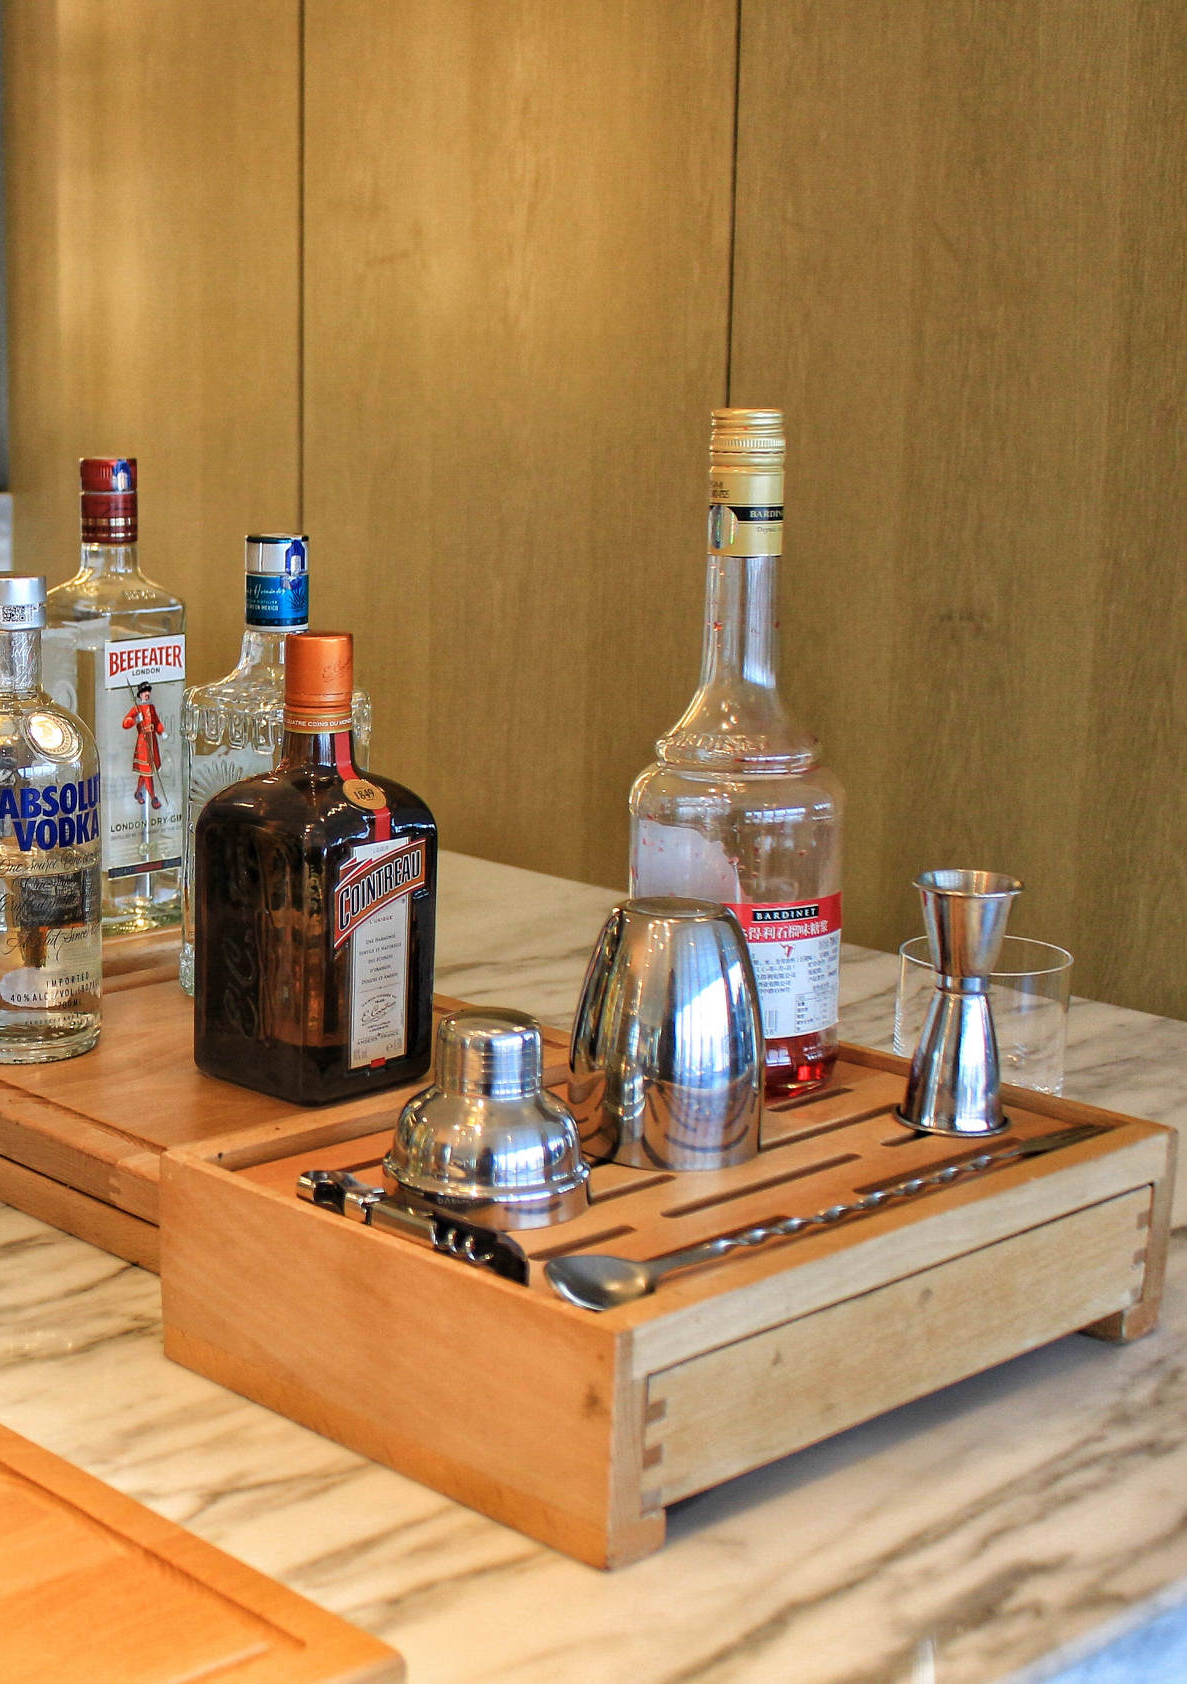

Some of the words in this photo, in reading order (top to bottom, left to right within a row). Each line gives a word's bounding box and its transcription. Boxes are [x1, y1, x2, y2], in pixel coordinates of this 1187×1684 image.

[108, 644, 183, 678] BEEFEATER
[131, 667, 161, 677] LONDON
[12, 808, 100, 852] VODKA
[110, 819, 147, 833] LONDON
[150, 816, 169, 827] DRY
[338, 849, 422, 933] COINTREAU
[755, 907, 817, 921] BARDINET
[46, 971, 90, 989] IMPORTED
